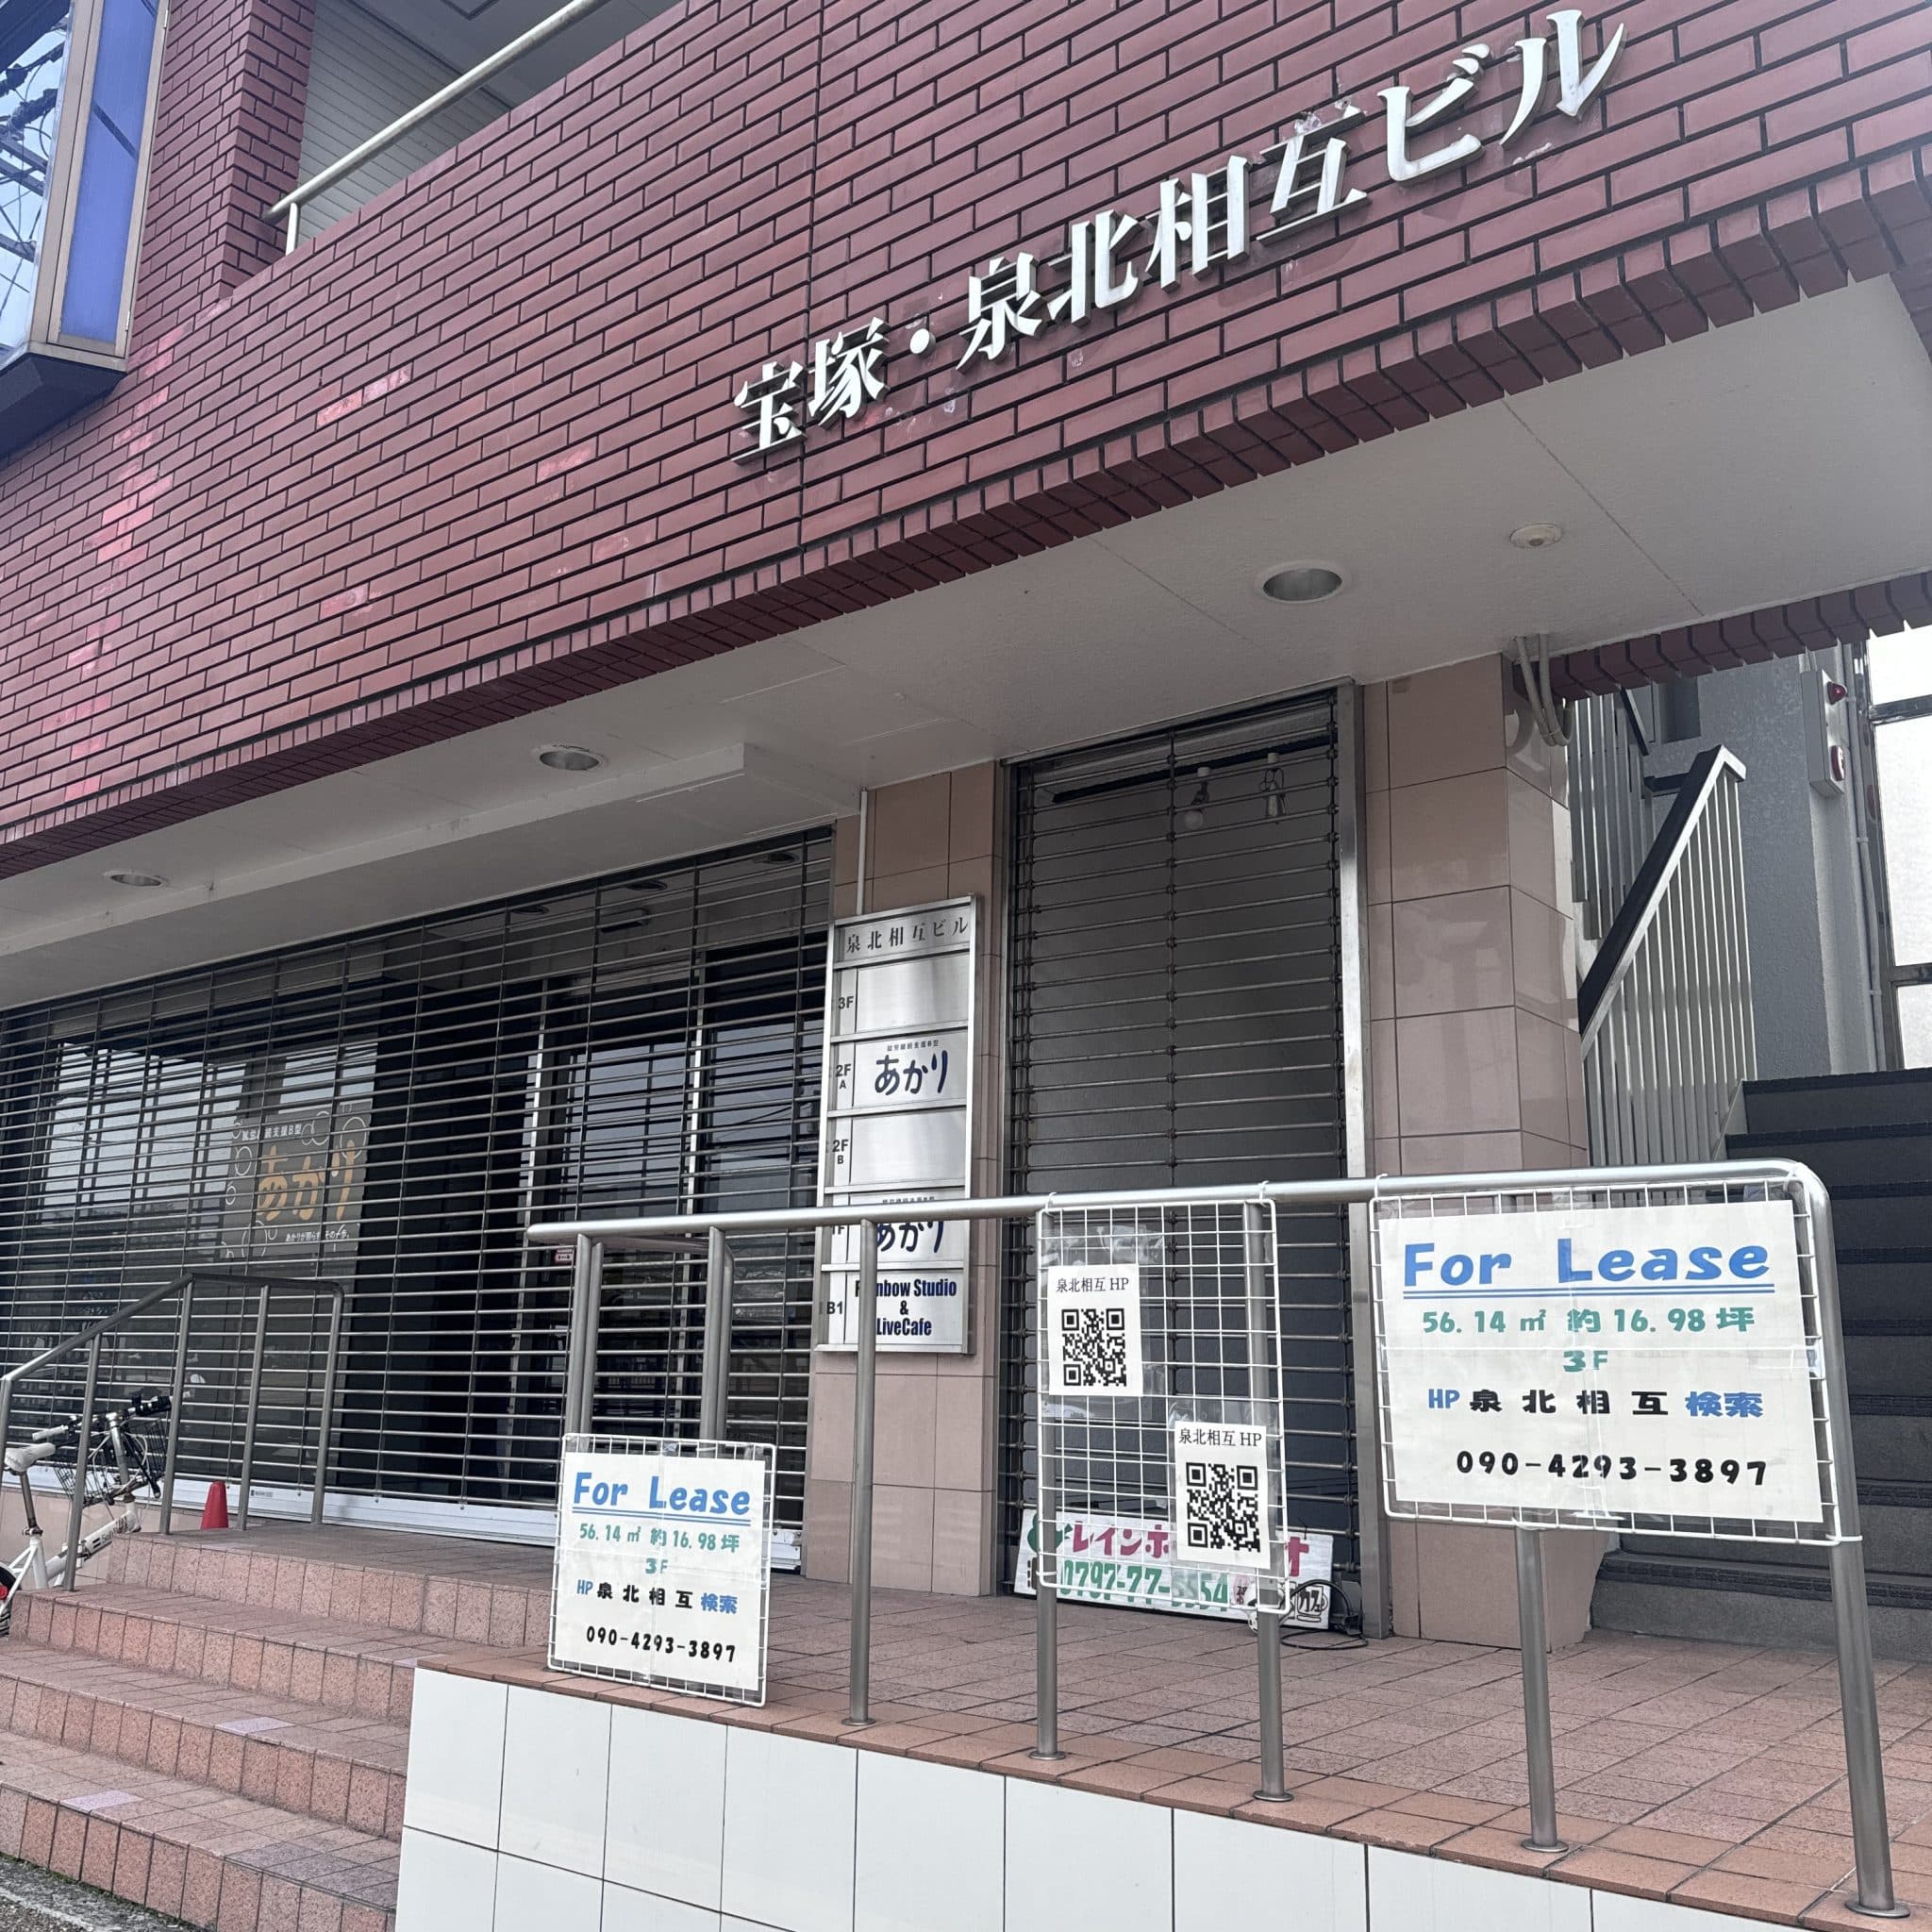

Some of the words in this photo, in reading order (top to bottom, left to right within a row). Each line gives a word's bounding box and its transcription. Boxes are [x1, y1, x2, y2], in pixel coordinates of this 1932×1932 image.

[732, 8, 1627, 463] 宝塚・泉北相互ビル
[846, 916, 969, 955] 泉北相互ビル
[838, 995, 855, 1009] 3F
[836, 1063, 851, 1077] 2F
[874, 1050, 948, 1096] あかり
[832, 1139, 849, 1153] 2F
[837, 1155, 844, 1165] B
[256, 1140, 357, 1222] あかり
[1404, 1242, 1512, 1287] For
[1557, 1237, 1769, 1283] Lease
[913, 1278, 957, 1297] Studio
[1056, 1277, 1107, 1293] 泉北相互
[1109, 1278, 1129, 1291] HP
[826, 1302, 843, 1315] B1
[899, 1300, 909, 1315] &
[876, 1317, 932, 1337] LiveCafe
[1562, 1349, 1608, 1373] 3F
[1427, 1388, 1460, 1409] HP
[1685, 1391, 1764, 1419] 検索
[1178, 1428, 1236, 1447] 泉北相互
[1239, 1432, 1262, 1447] HP
[1457, 1450, 1767, 1487] 090-4293-3897
[574, 1472, 628, 1507] For
[649, 1475, 751, 1516] Lease
[645, 1558, 668, 1574] 3F
[576, 1579, 593, 1595] HP
[700, 1592, 738, 1615] 検索
[586, 1625, 736, 1663] 090-4293-3897
